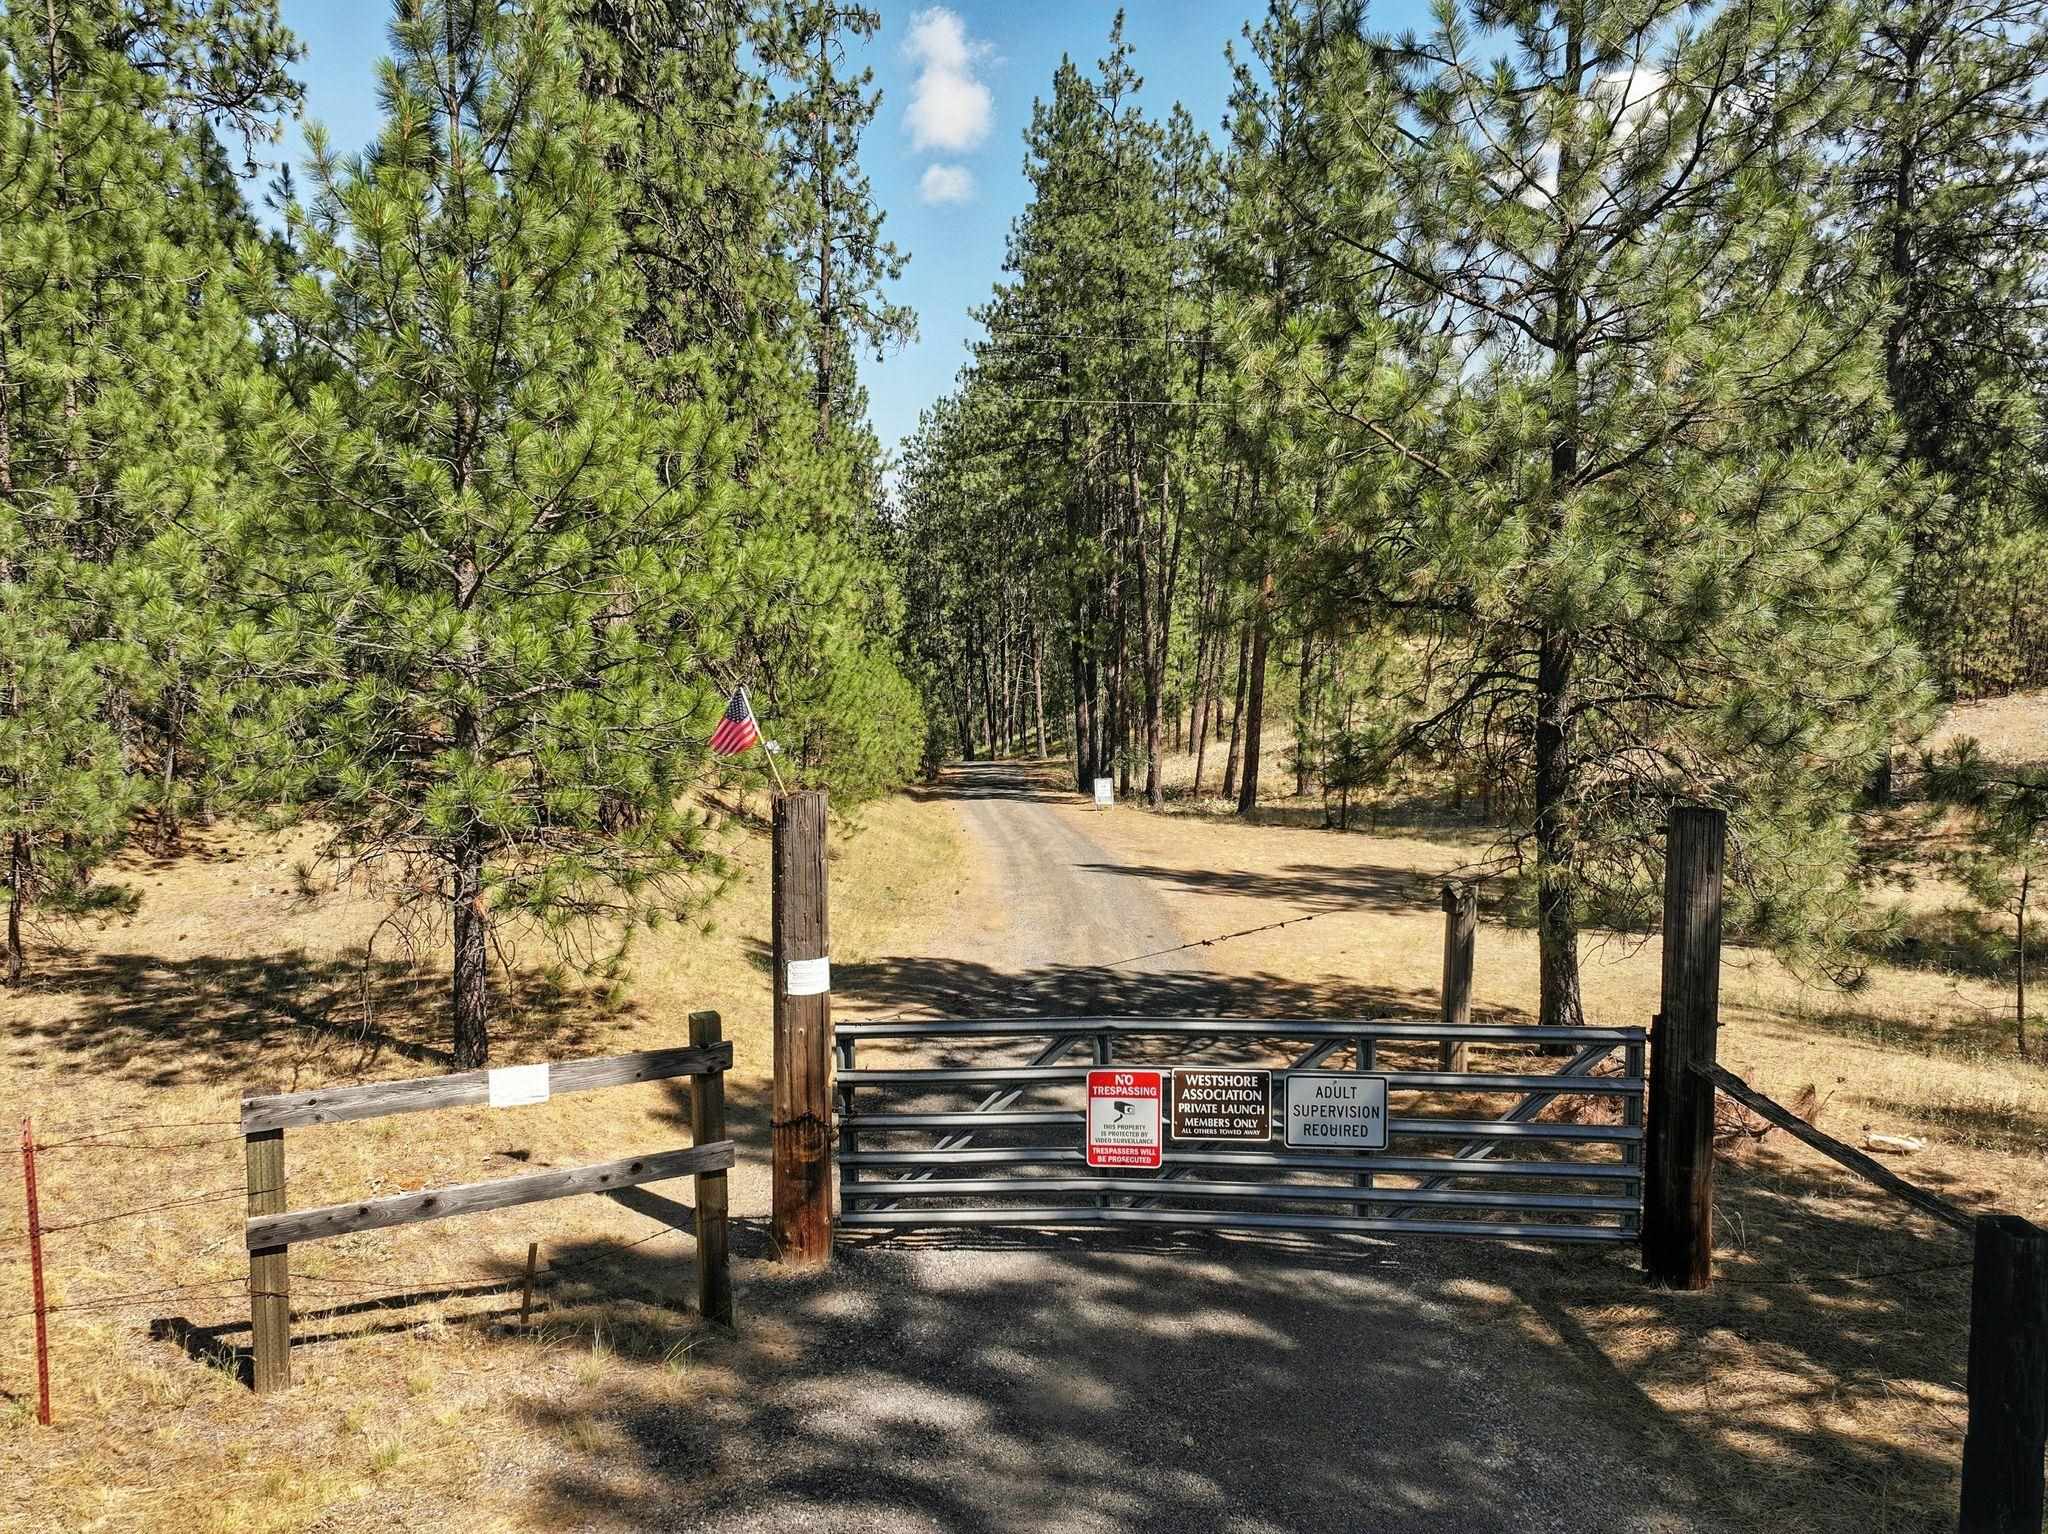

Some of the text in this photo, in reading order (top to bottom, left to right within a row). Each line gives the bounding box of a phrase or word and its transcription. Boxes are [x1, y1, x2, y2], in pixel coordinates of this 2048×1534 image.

[1115, 1074, 1134, 1085] NO
[1185, 1075, 1258, 1087] WESTSHORE
[1092, 1086, 1157, 1096] TRESPASSING
[1182, 1089, 1262, 1101] ASSOCIATION
[1315, 1086, 1357, 1099] ADULT
[1178, 1103, 1264, 1115] PRIVATE LAUNCH
[1293, 1104, 1380, 1119] SUPERVISION
[1184, 1118, 1258, 1128] MEMBERS ONLY
[1303, 1123, 1369, 1137] REQUIRED
[1092, 1147, 1139, 1155] TRESPASSERS
